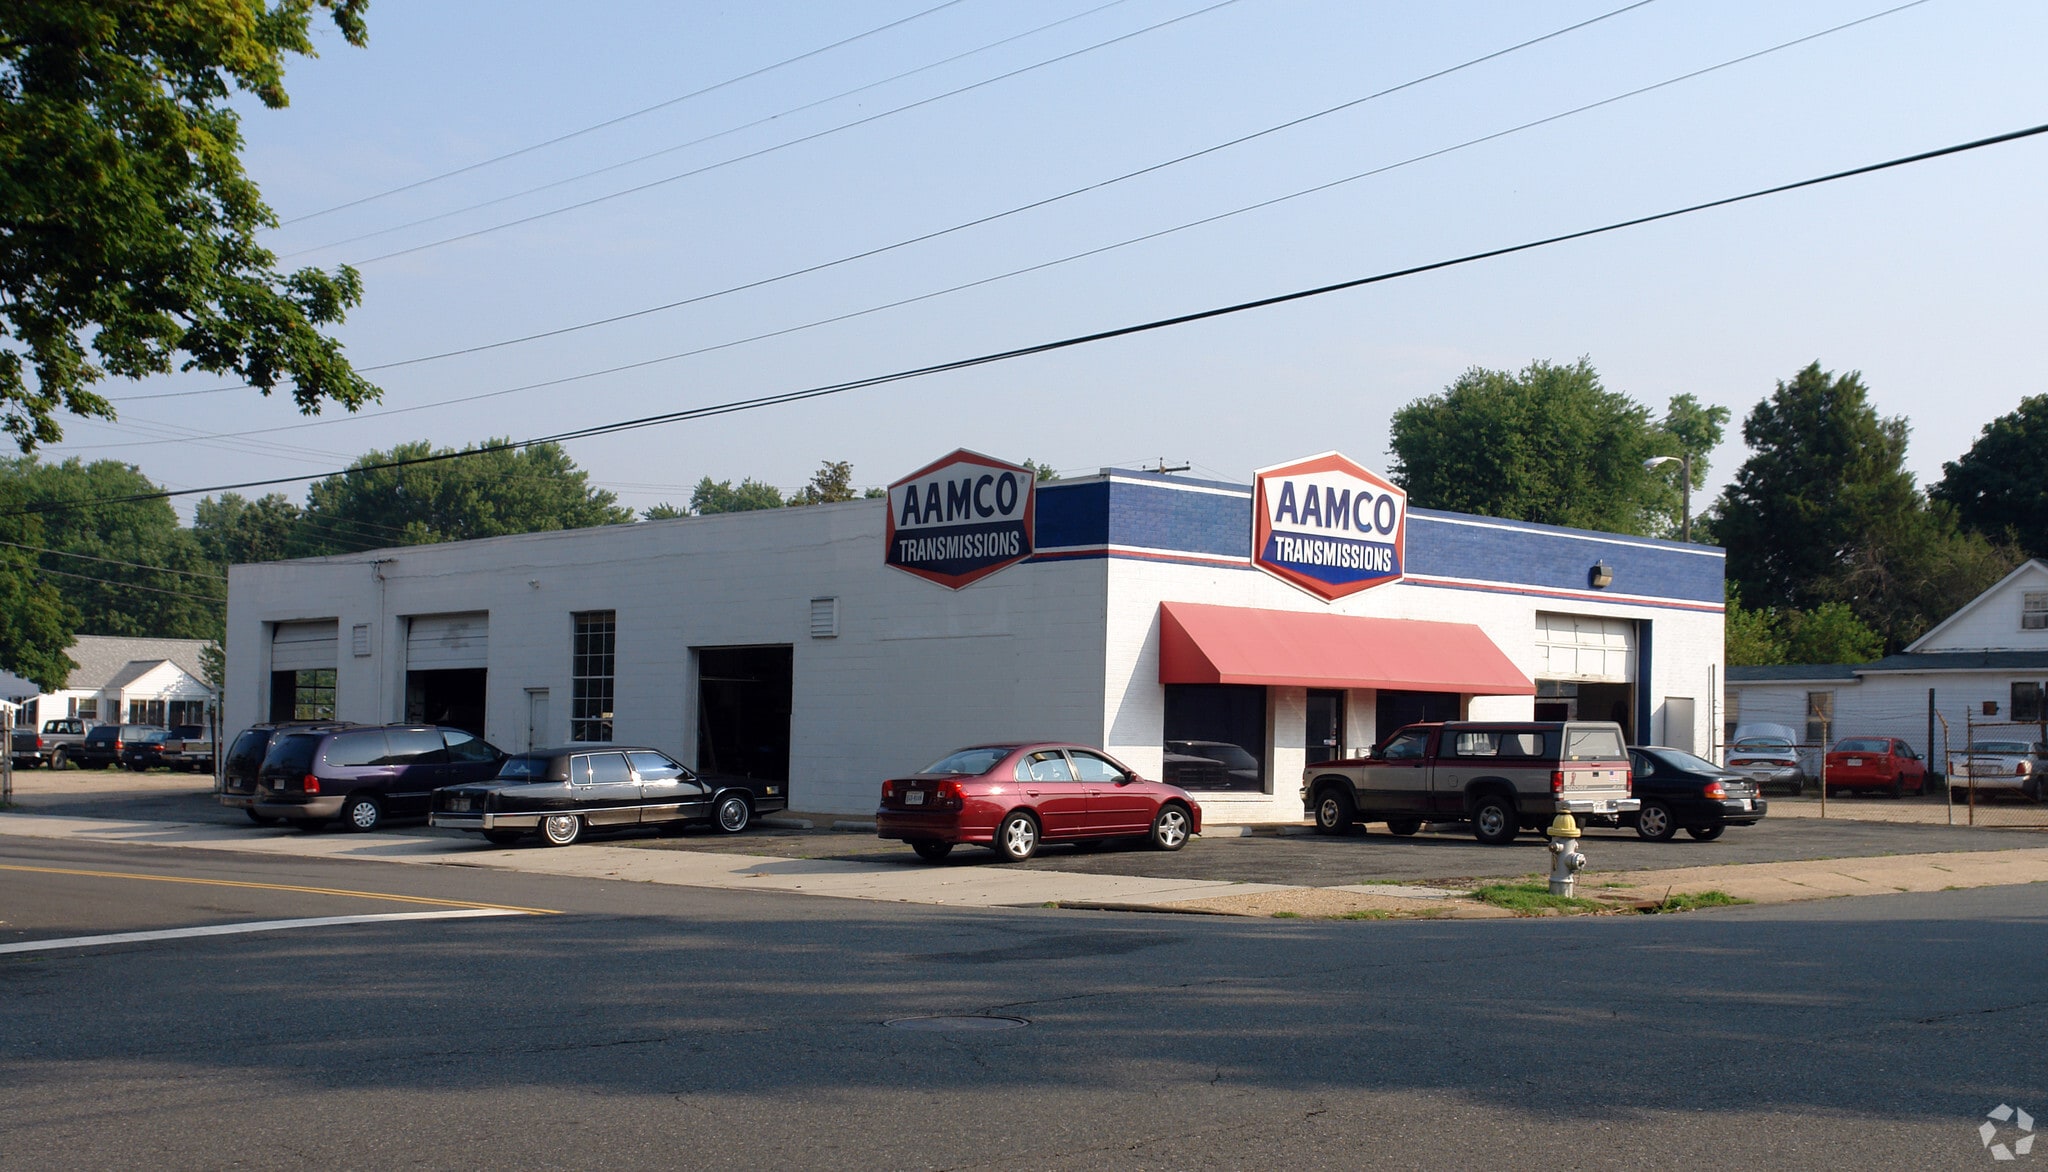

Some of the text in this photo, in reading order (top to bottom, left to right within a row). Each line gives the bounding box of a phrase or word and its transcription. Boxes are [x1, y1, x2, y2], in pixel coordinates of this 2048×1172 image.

[901, 472, 1018, 526] AAMCO
[1275, 481, 1396, 535] AAMCO
[900, 531, 1020, 562] TRANSMISSIONS
[1275, 536, 1392, 572] TRANSMISSIONS
